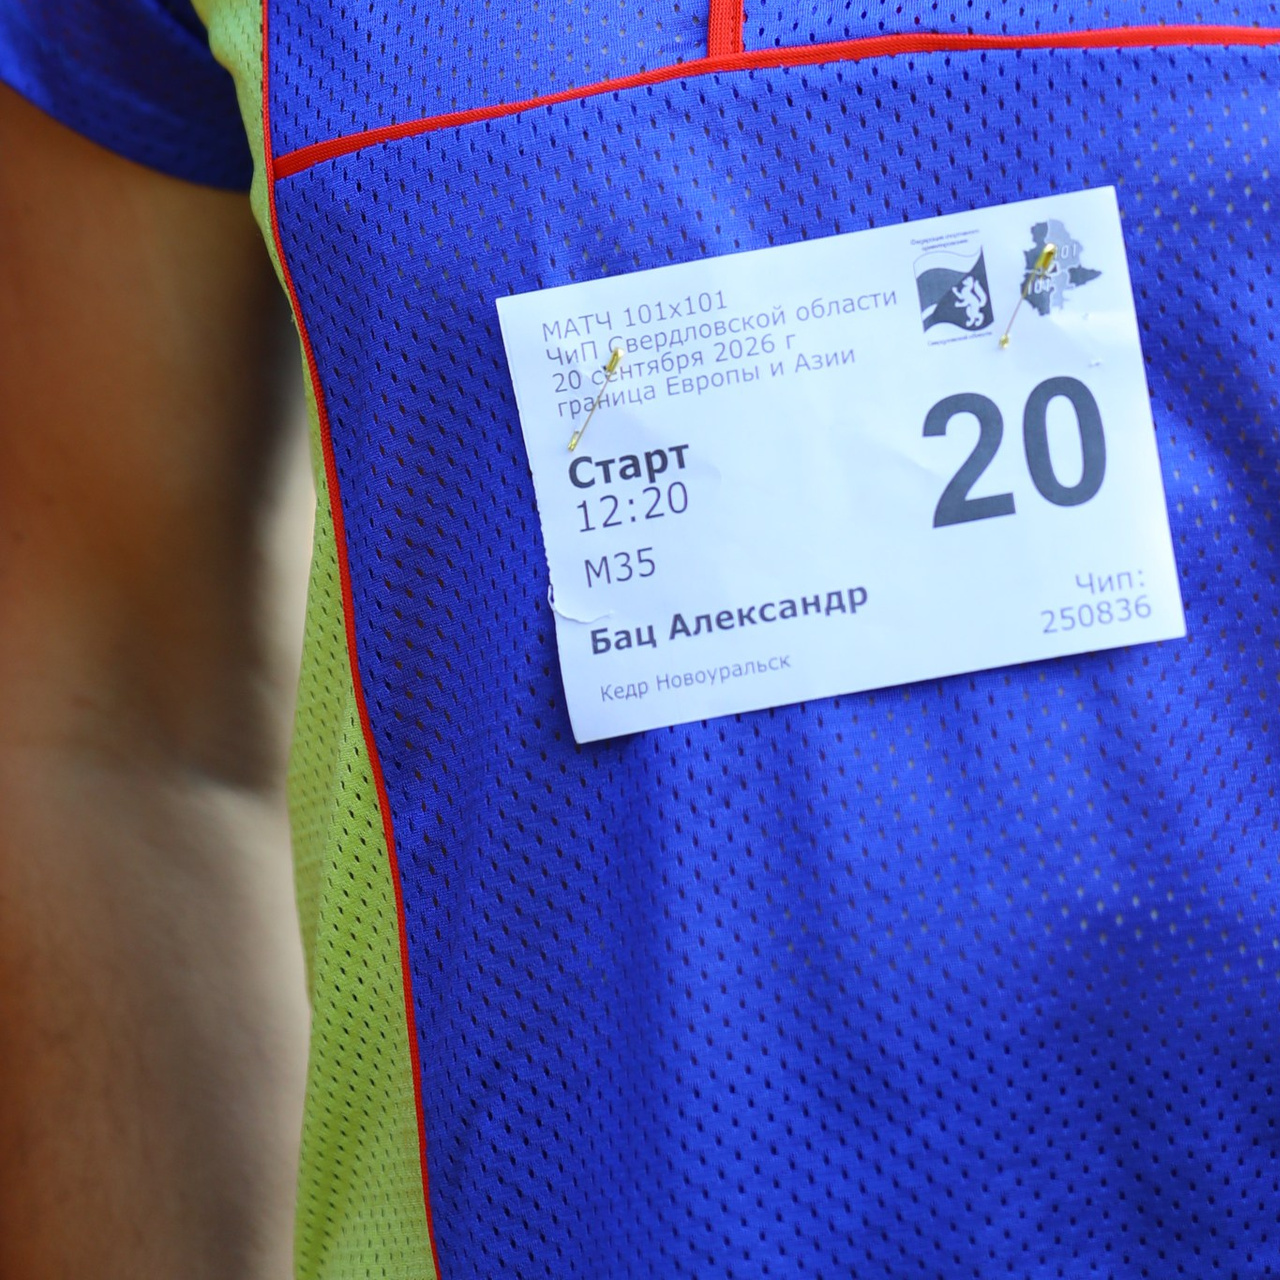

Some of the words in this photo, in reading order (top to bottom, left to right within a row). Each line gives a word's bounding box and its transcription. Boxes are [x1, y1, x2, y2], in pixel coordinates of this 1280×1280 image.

[542, 311, 612, 342] МАТЧ
[546, 341, 598, 366] ЧиП
[608, 307, 786, 354] Свердловской
[796, 289, 898, 320] области
[552, 370, 582, 393] 20
[591, 351, 704, 386] сентября
[716, 335, 777, 363] 2026
[786, 333, 798, 352] г
[558, 384, 656, 419] граница
[666, 366, 761, 397] Европы
[770, 360, 785, 378] и
[794, 347, 857, 374] Азии
[568, 444, 689, 489] Старт
[922, 376, 1107, 528] 20
[576, 481, 689, 533] 12:20
[1075, 569, 1145, 595] Чип:
[590, 625, 657, 655] Бац
[669, 585, 869, 641] Александр
[1040, 594, 1152, 634] 250836
[600, 679, 649, 702] Кедр
[656, 654, 792, 692] Новоуральск
